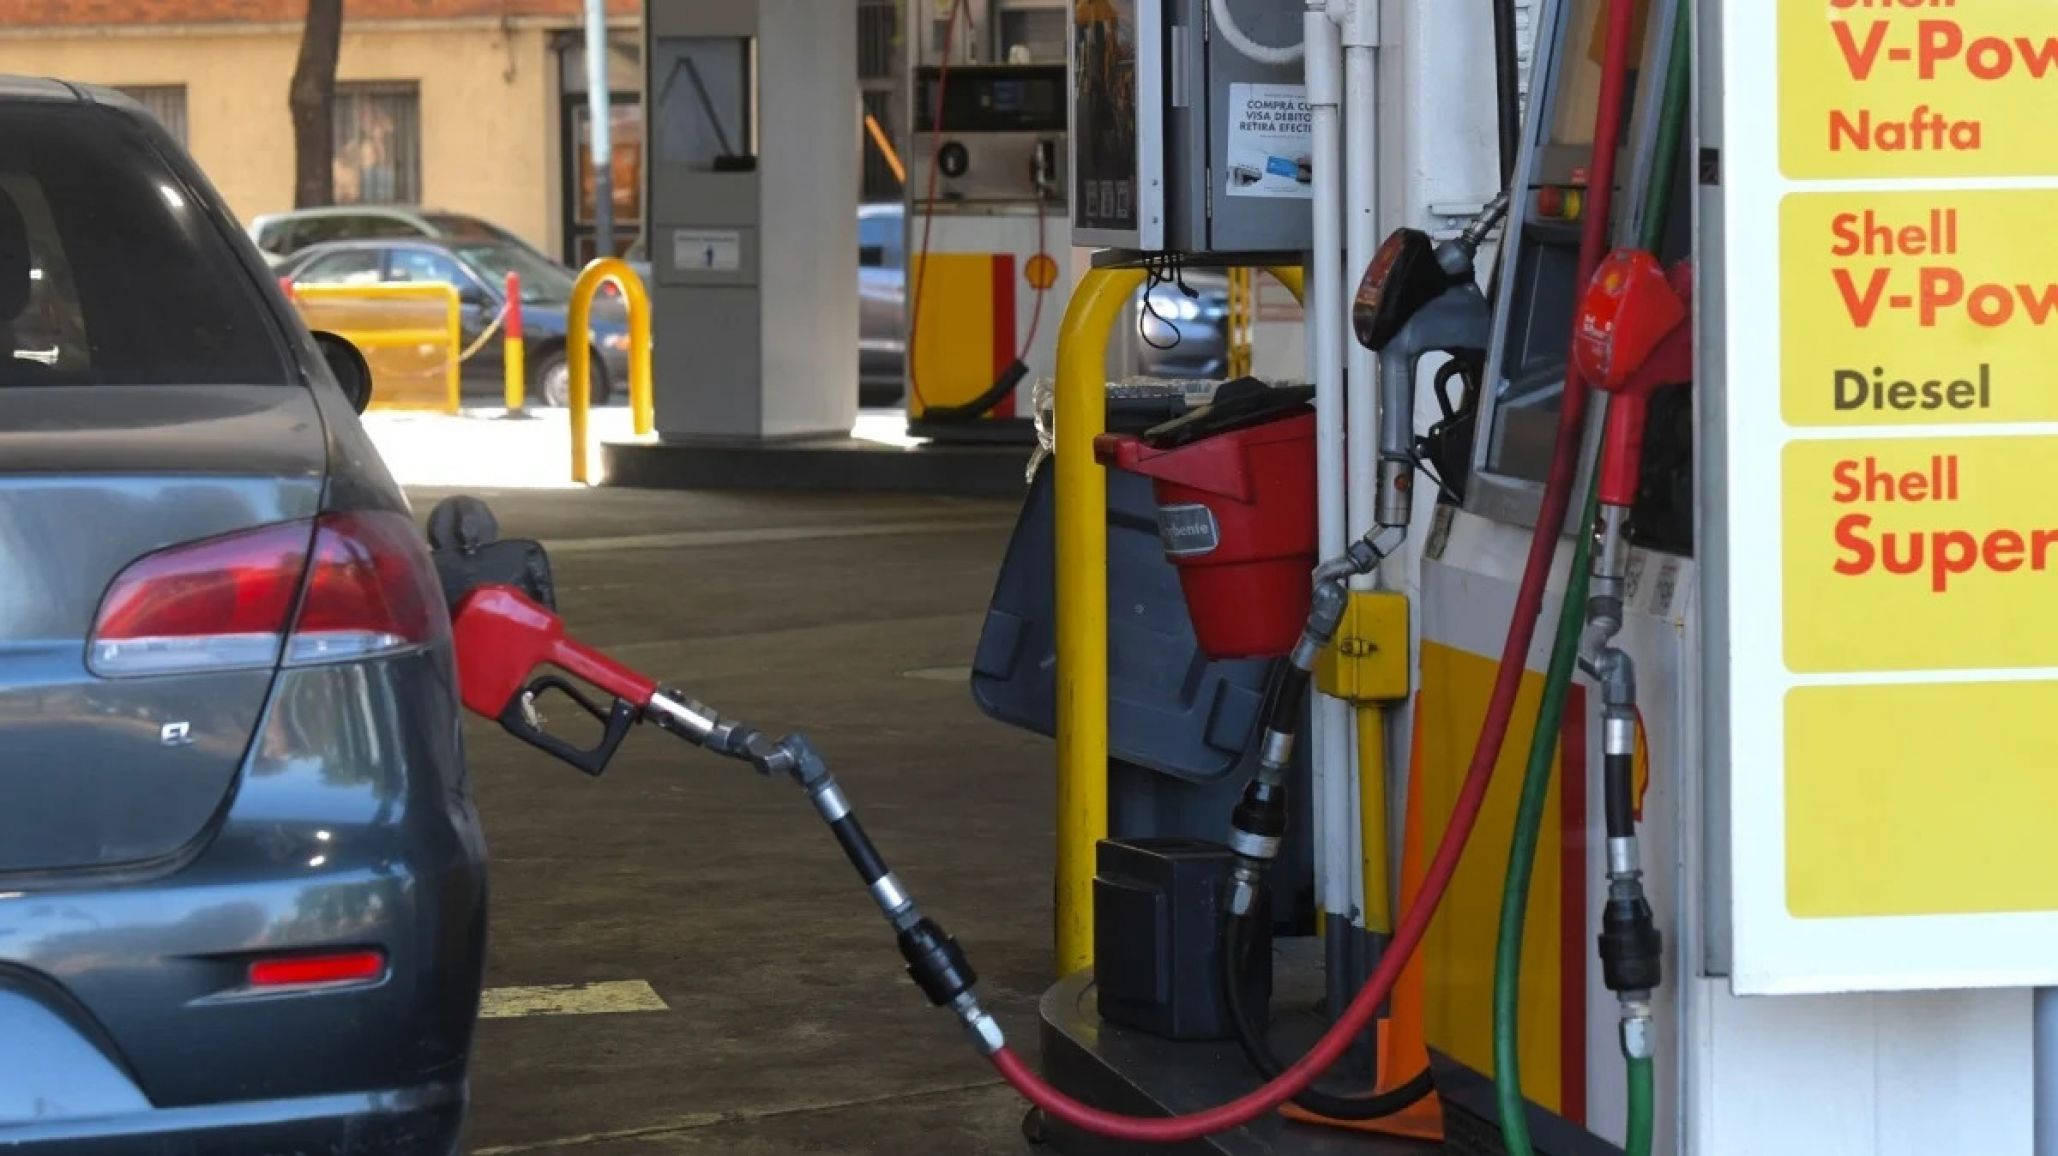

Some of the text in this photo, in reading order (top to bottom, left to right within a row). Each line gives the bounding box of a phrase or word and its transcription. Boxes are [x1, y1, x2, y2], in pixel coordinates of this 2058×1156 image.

[1246, 111, 1271, 121] VISA
[1828, 105, 1981, 151] Nafta
[1831, 208, 1957, 256] Shell
[1833, 363, 1991, 410] Diesel
[1833, 455, 1959, 503] Shell
[1833, 513, 2058, 592] Super
